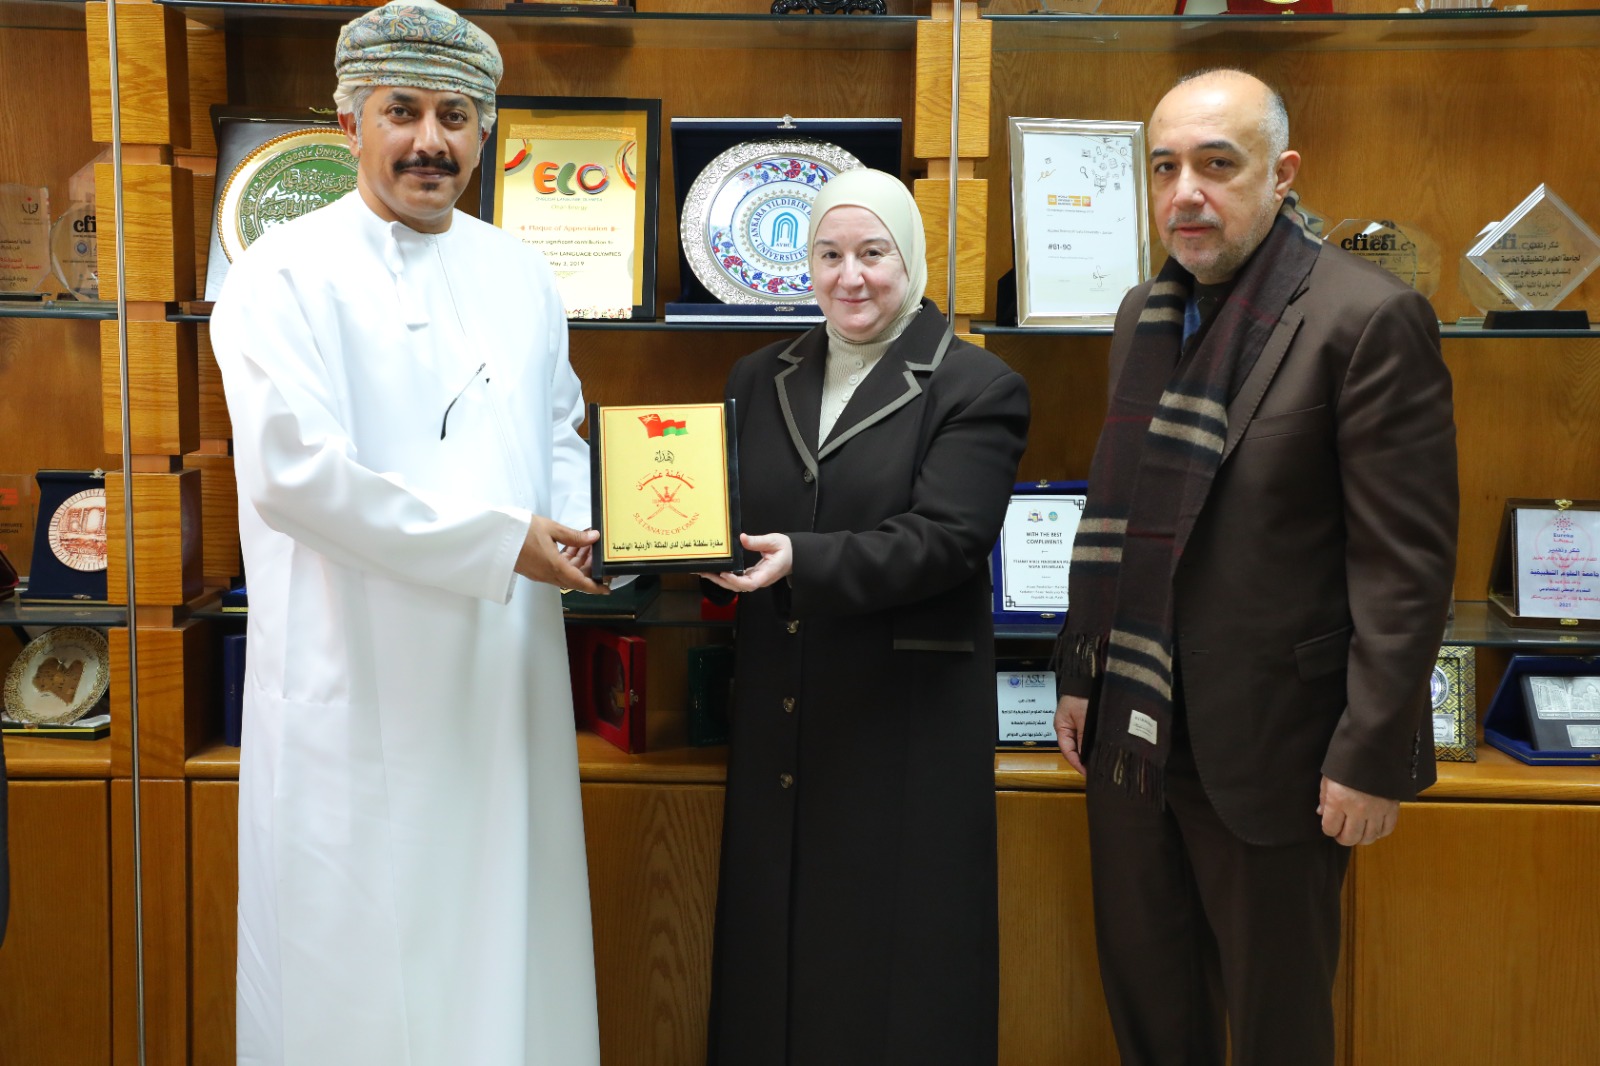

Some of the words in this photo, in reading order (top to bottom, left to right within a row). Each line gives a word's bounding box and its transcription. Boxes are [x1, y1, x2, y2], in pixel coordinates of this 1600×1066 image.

[315, 147, 359, 166] UNIVERSI
[73, 215, 97, 233] cfi
[751, 208, 767, 238] ANKARA
[766, 198, 808, 211] YILDIRIM
[633, 512, 670, 536] SULTANATE
[671, 527, 682, 535] OF
[681, 512, 700, 531] OMAN
[1026, 674, 1046, 684] ASU
